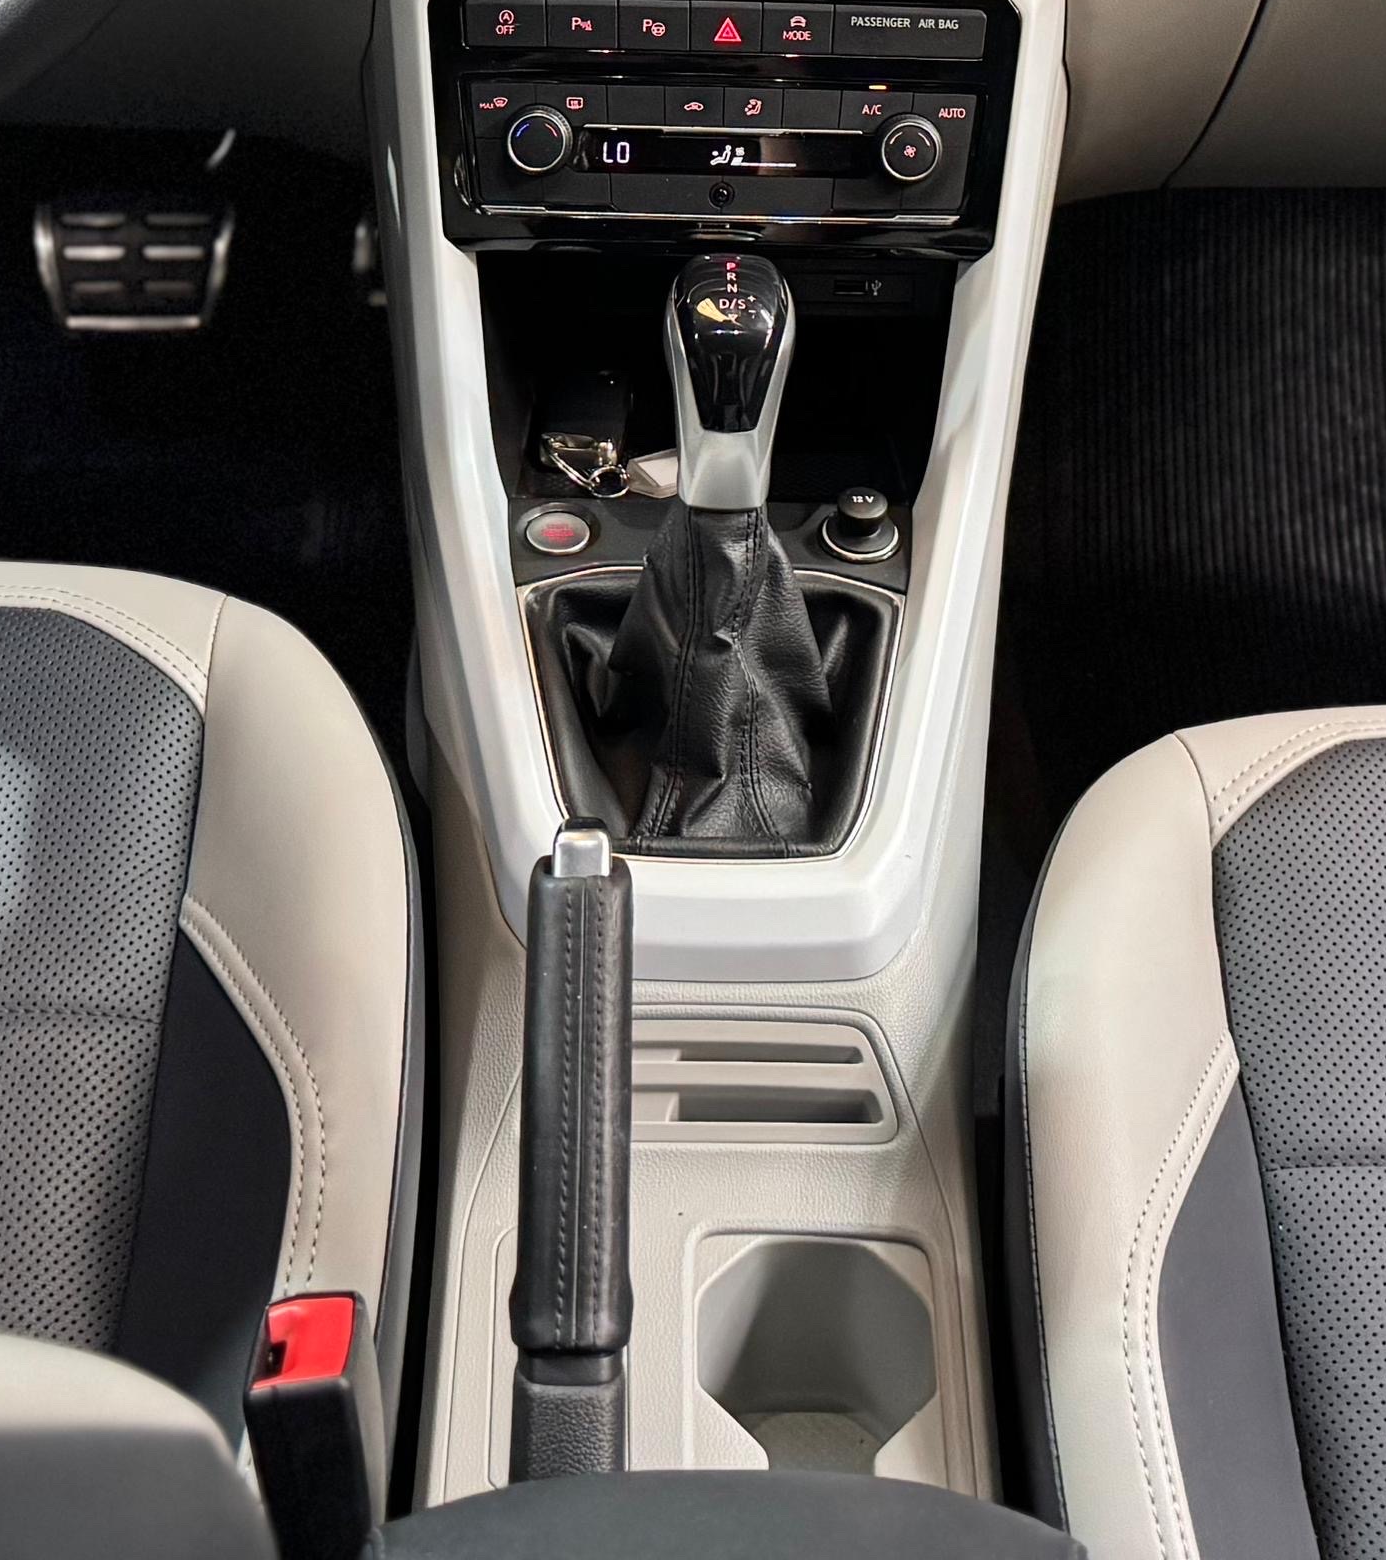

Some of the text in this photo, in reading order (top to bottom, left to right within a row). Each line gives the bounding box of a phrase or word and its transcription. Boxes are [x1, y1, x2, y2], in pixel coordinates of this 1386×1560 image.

[851, 16, 959, 30] PASSENGER AIR BAG
[496, 25, 514, 35] OFF
[783, 31, 812, 41] MODE
[862, 104, 882, 115] A/C
[938, 108, 966, 119] AUTO
[603, 142, 630, 163] LO
[726, 262, 736, 271] P
[727, 272, 736, 281] R
[727, 283, 738, 293] N
[719, 298, 746, 310] D/S
